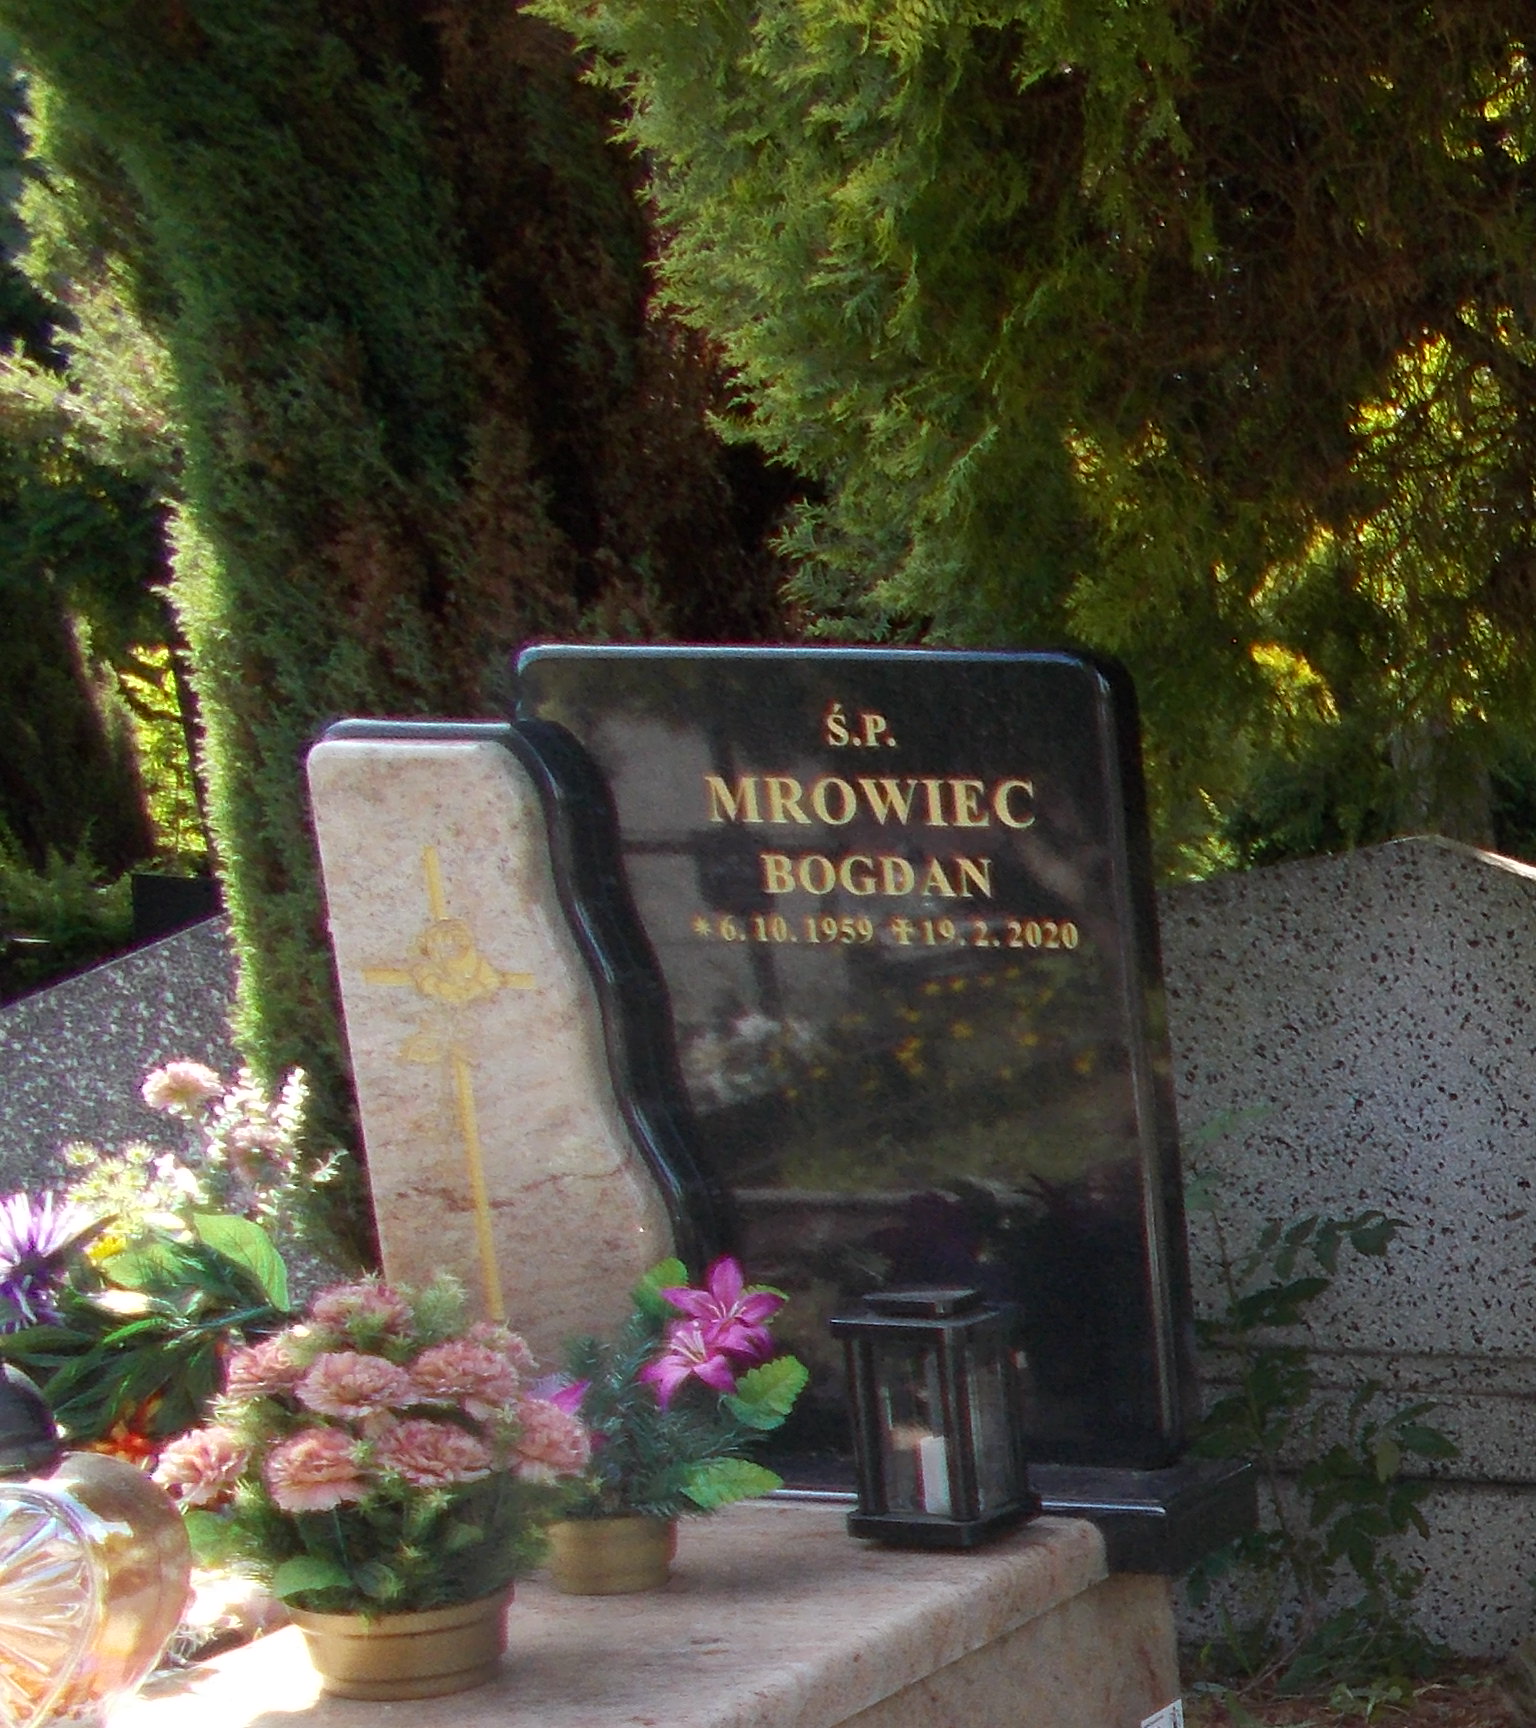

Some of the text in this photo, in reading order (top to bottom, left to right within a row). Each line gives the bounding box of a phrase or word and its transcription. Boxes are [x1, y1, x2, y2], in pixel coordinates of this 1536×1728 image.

[826, 703, 896, 747] Ś.P.
[704, 775, 1036, 828] MROWIEC
[760, 853, 993, 899] BOGDAN
